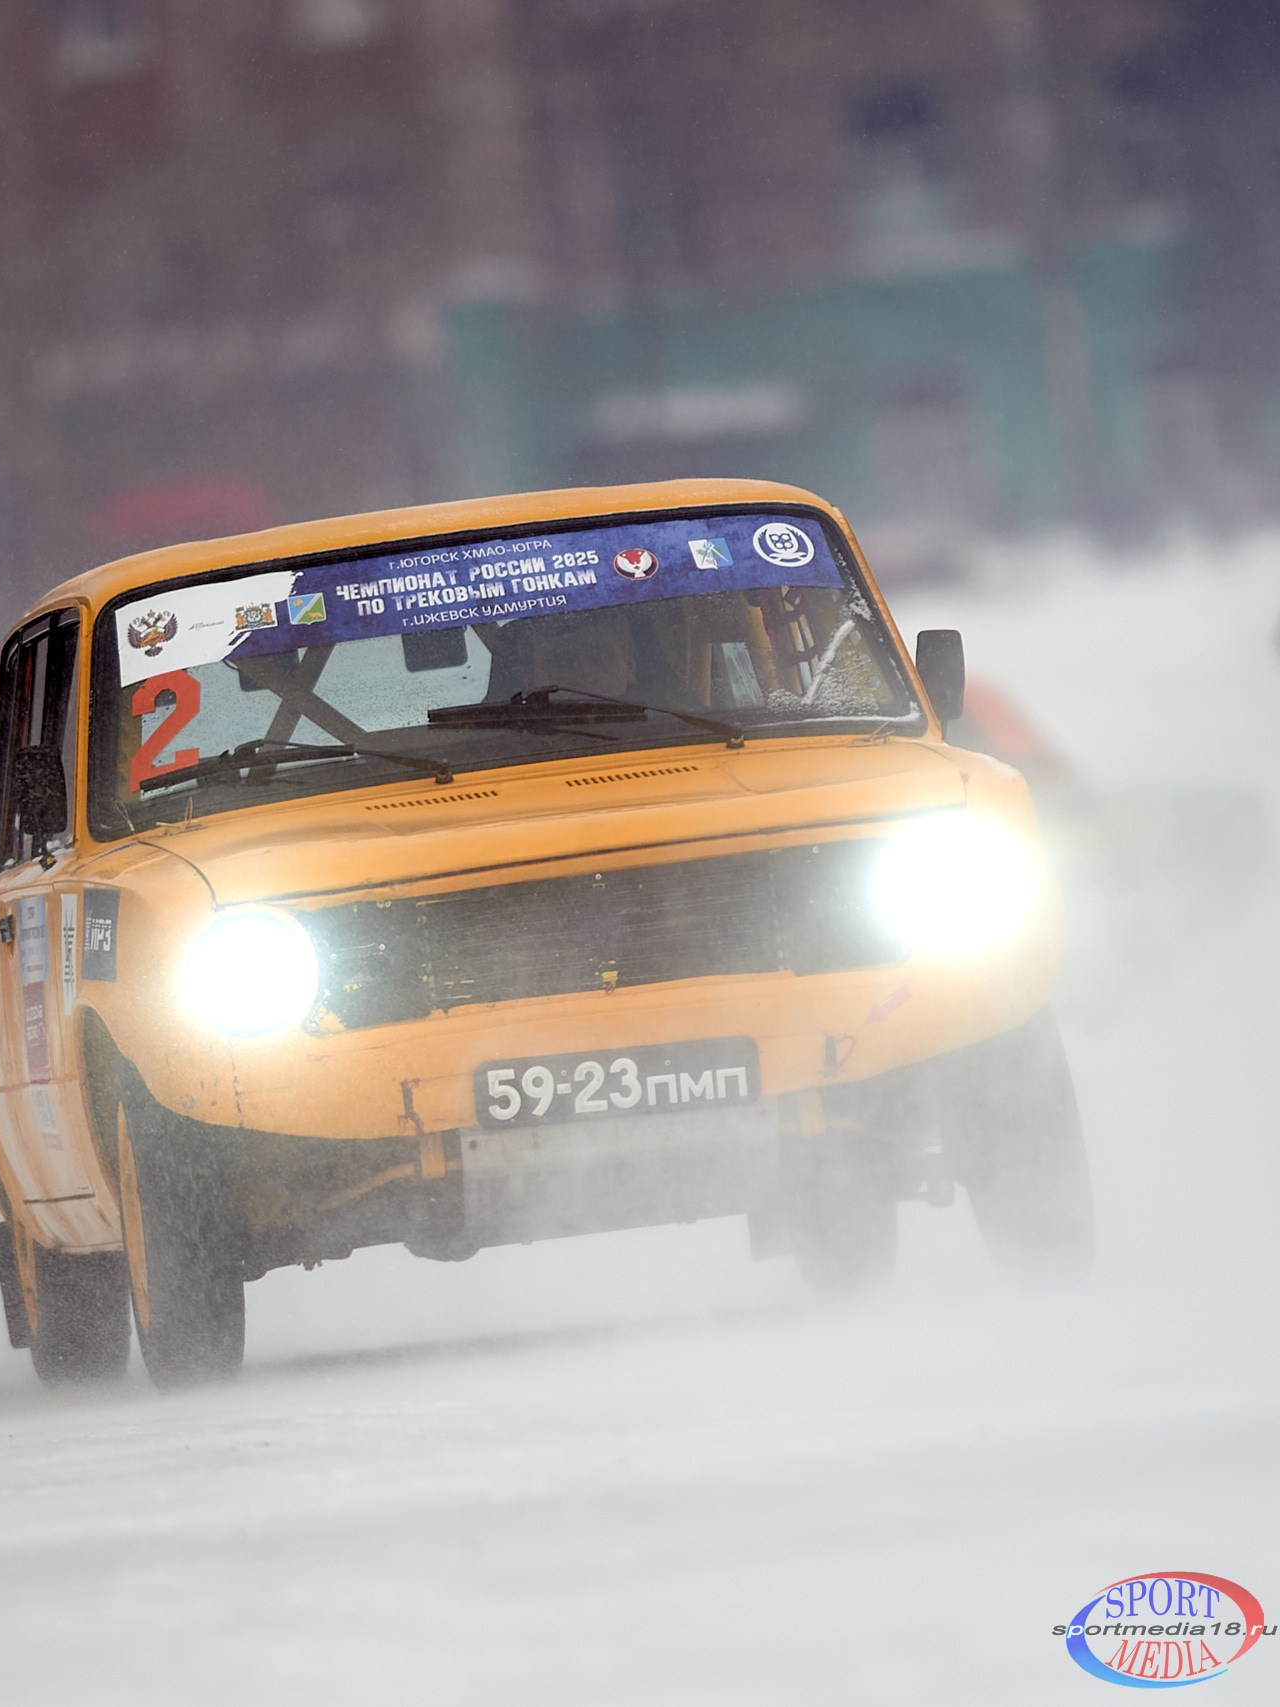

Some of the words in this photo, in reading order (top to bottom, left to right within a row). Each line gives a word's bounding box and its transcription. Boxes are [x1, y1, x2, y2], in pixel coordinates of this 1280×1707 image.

[335, 569, 458, 601] ЧЕМПИОНАТ
[469, 557, 546, 582] РОССИИ
[552, 550, 600, 570] 2025
[389, 552, 459, 570] г.ЮГОРСК
[463, 539, 553, 560] ХМАО-ЮГРА
[357, 597, 385, 617] ПО
[394, 582, 506, 612] ТРЕКОВЫМ
[511, 569, 598, 594] ГОНКАМ
[402, 607, 481, 628] г.ИЖЕВСК
[483, 594, 568, 617] УДМУРТИЯ
[129, 669, 201, 793] 2
